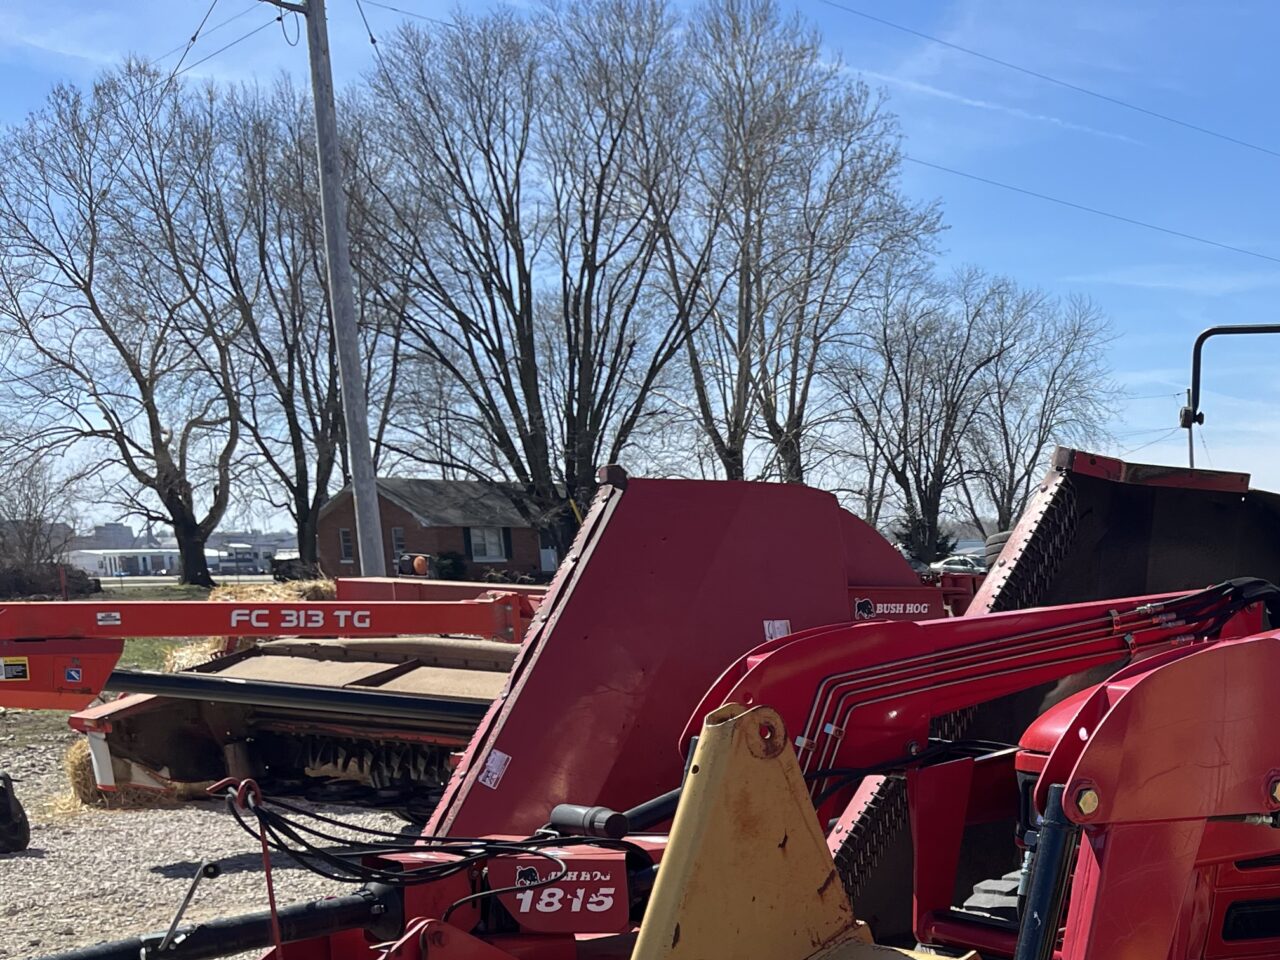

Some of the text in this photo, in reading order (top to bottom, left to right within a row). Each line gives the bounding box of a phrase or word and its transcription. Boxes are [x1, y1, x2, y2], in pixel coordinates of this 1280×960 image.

[876, 603, 928, 614] BUSH HOG
[231, 609, 371, 628] FC 313 TG
[516, 887, 616, 913] 1815
